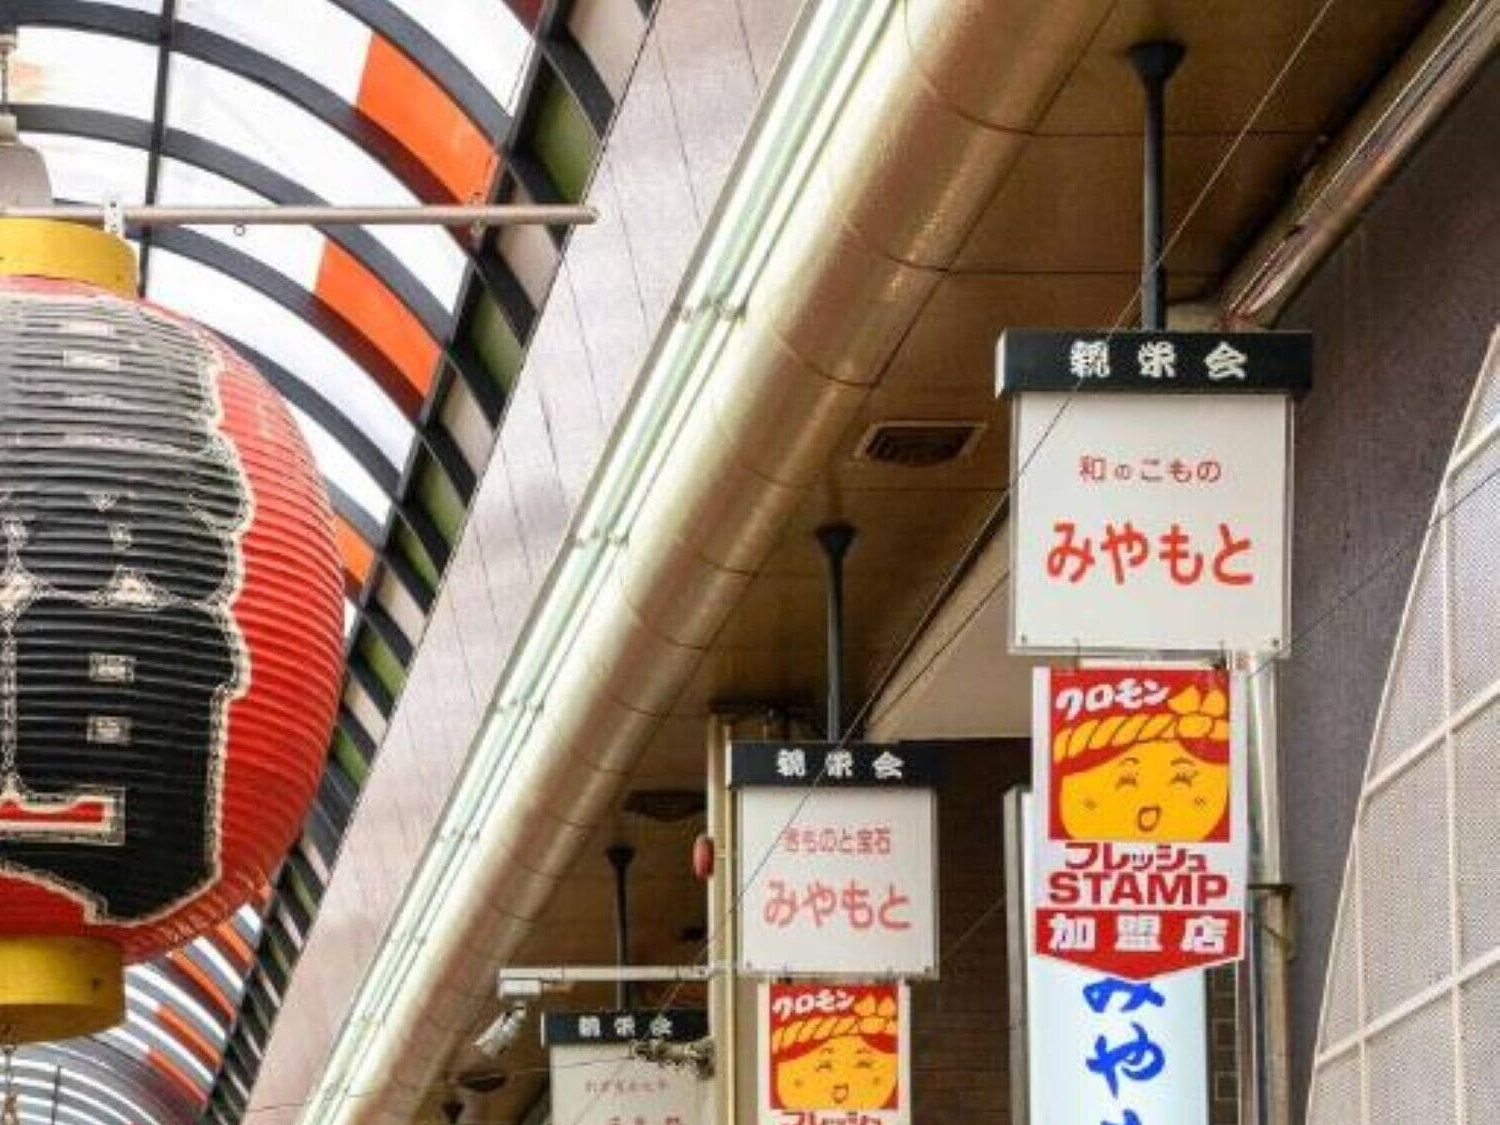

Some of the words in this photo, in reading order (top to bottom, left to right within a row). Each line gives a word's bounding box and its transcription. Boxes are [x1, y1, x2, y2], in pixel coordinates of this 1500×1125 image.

[1078, 455, 1223, 484] 和のこもの
[1047, 520, 1253, 586] みやもと
[1055, 678, 1170, 721] クロモン
[1064, 841, 1208, 873] フレッシュ
[762, 880, 913, 932] みやもと
[1048, 871, 1229, 905] STAMP
[1048, 912, 1229, 954] 加盟店
[772, 991, 854, 1020] クロモン
